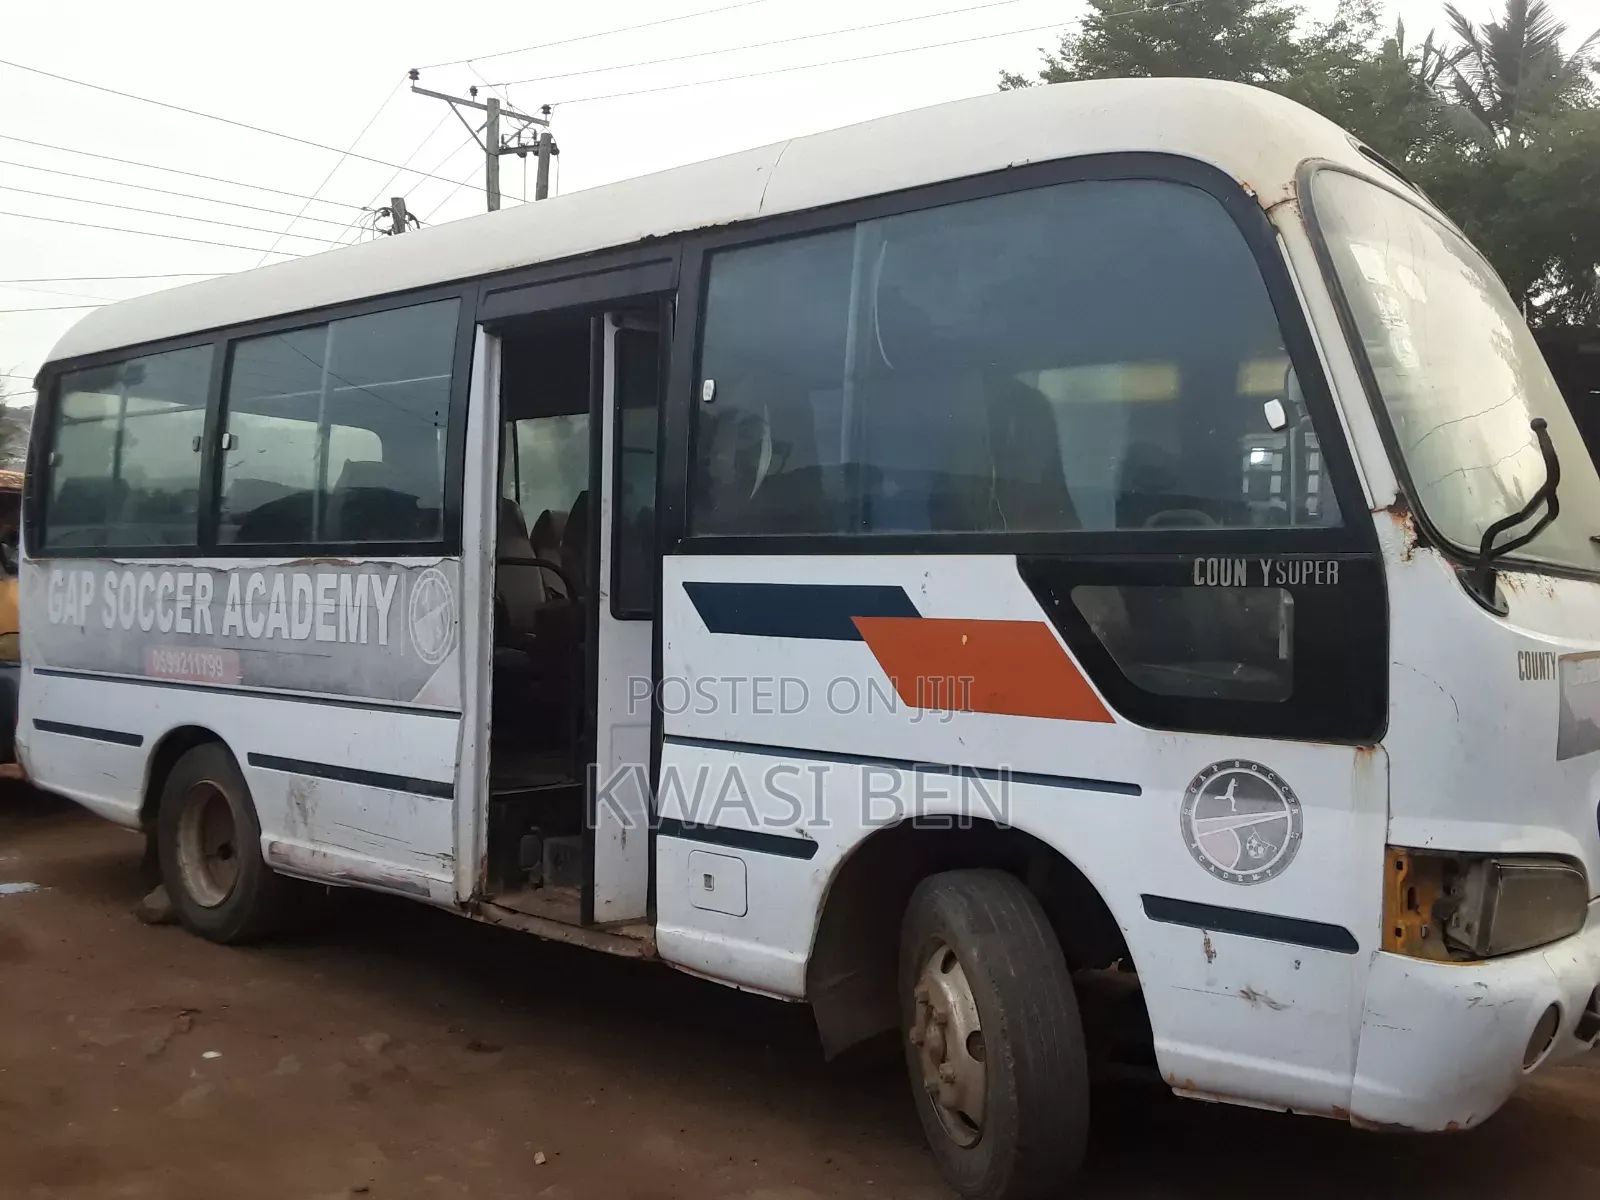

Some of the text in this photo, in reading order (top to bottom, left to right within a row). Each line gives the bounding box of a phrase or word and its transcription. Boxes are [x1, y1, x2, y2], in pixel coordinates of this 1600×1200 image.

[47, 569, 95, 627] GAP
[101, 570, 215, 634] SOCCER
[221, 572, 399, 646] ACADEMY
[1517, 650, 1556, 681] COUNTY
